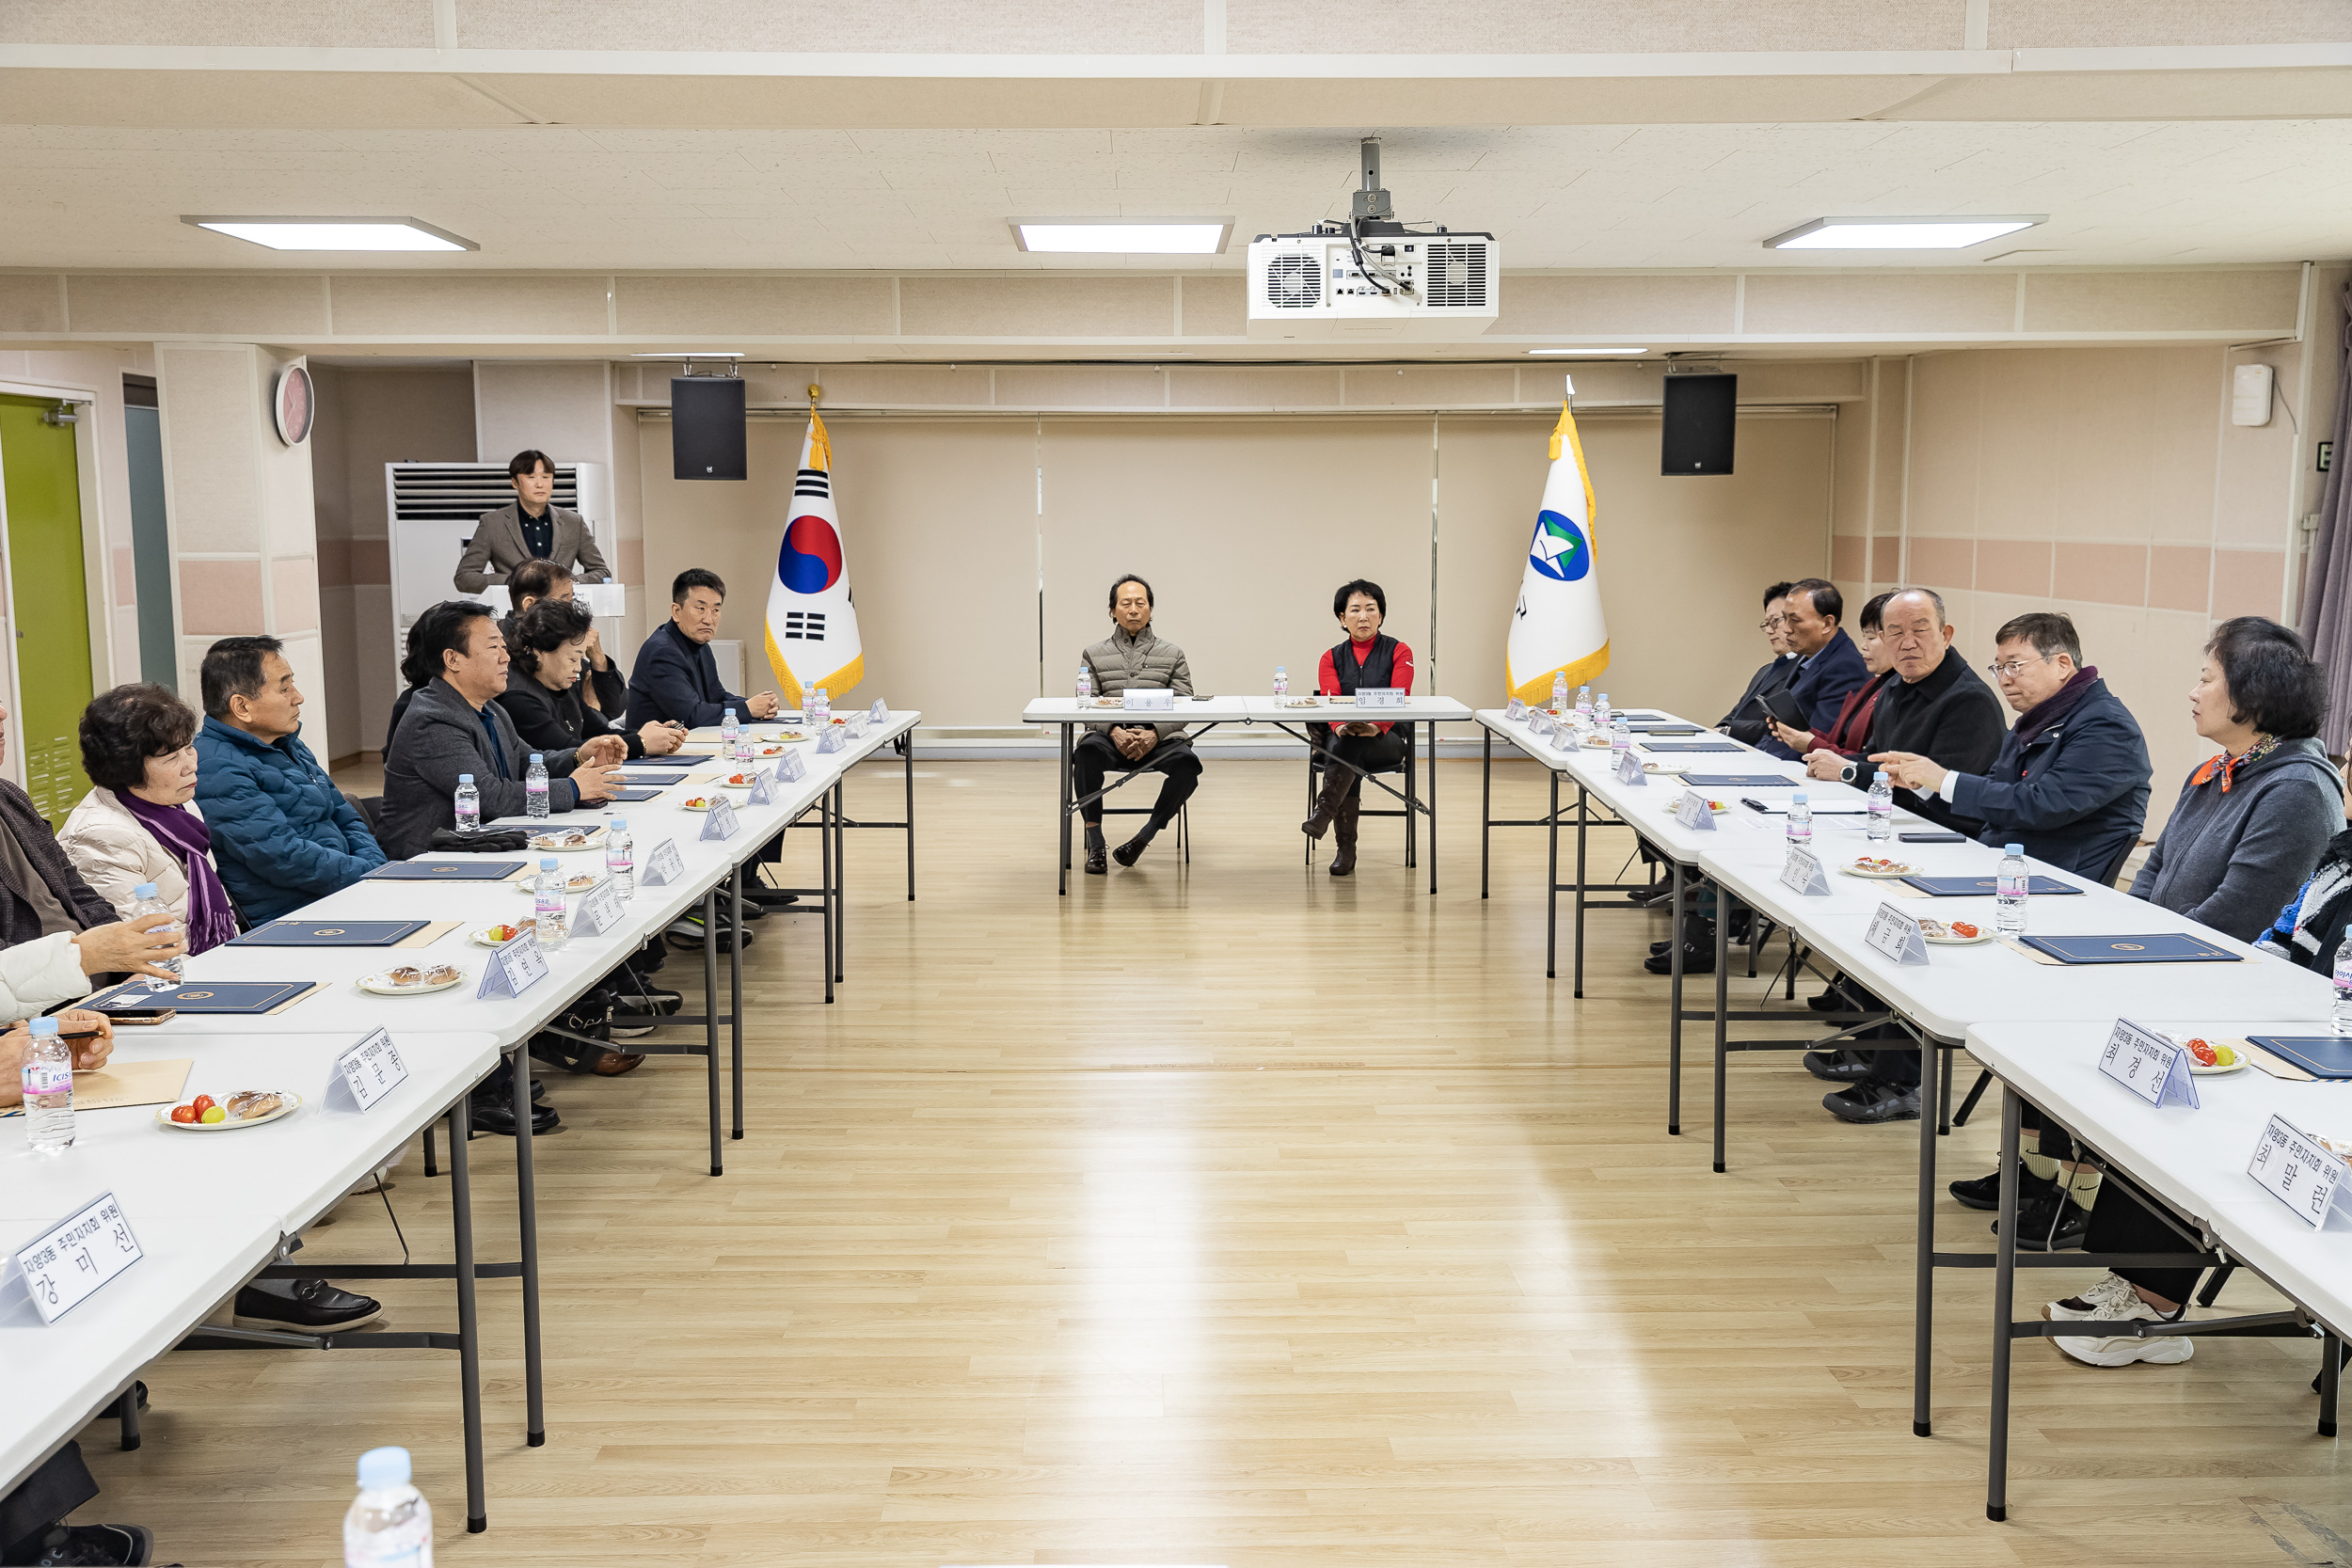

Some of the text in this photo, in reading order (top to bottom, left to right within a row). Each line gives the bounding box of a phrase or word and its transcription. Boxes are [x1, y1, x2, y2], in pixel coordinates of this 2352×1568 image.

[507, 950, 544, 986] 김 연 옥
[343, 1036, 391, 1074] 자양3동 주민자치회 위원
[2106, 1043, 2166, 1095] 최 경 선
[2114, 1026, 2172, 1069] 자양3동 주민자치회 위원
[353, 1050, 401, 1100] 김 문 종
[2256, 1143, 2328, 1215] 최 말 련
[2266, 1123, 2339, 1185] 자양3동 주민자치회 위원
[23, 1205, 119, 1275] 자양3동 주민자치회 위원
[36, 1223, 135, 1305] 강 미 선
